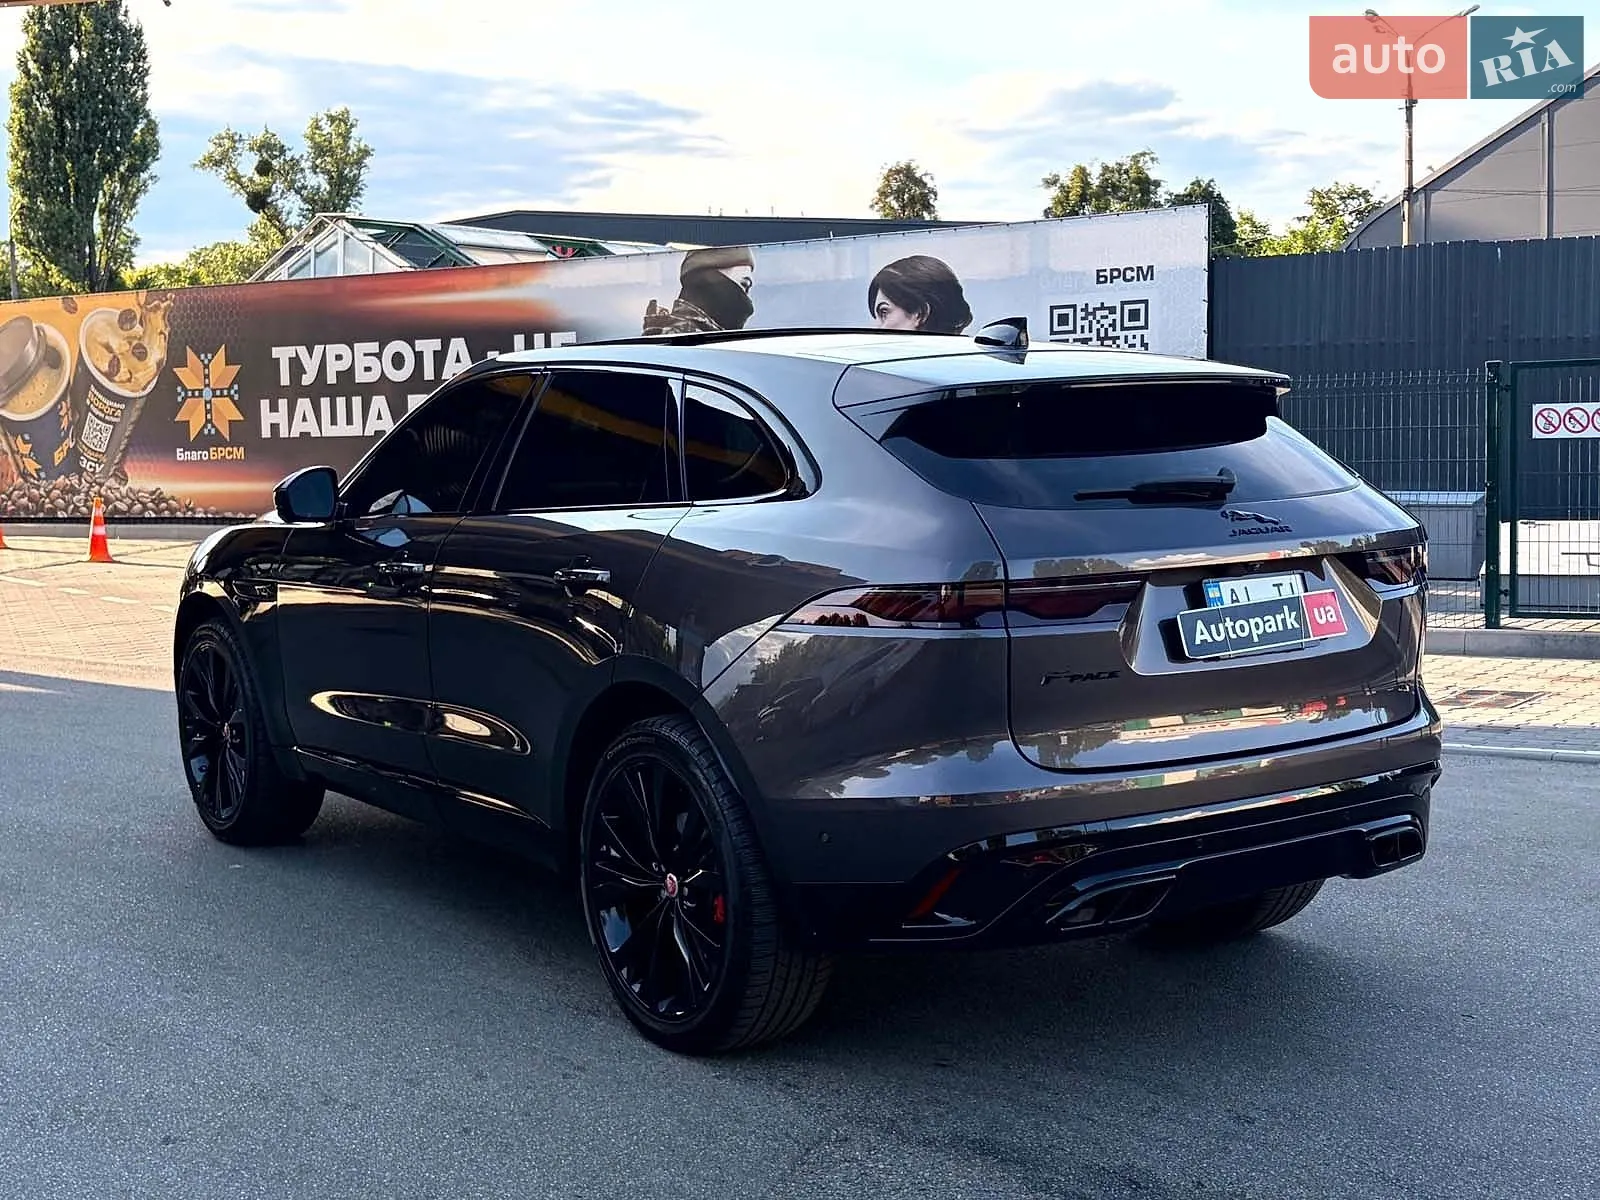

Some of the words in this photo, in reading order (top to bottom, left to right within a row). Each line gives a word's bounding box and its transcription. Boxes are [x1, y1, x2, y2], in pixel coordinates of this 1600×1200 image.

[1095, 265, 1155, 285] БРСМ
[271, 337, 473, 387] ТУРБОТА
[259, 395, 395, 439] НАША
[1194, 605, 1300, 645] Autopark
[1313, 604, 1337, 625] ua
